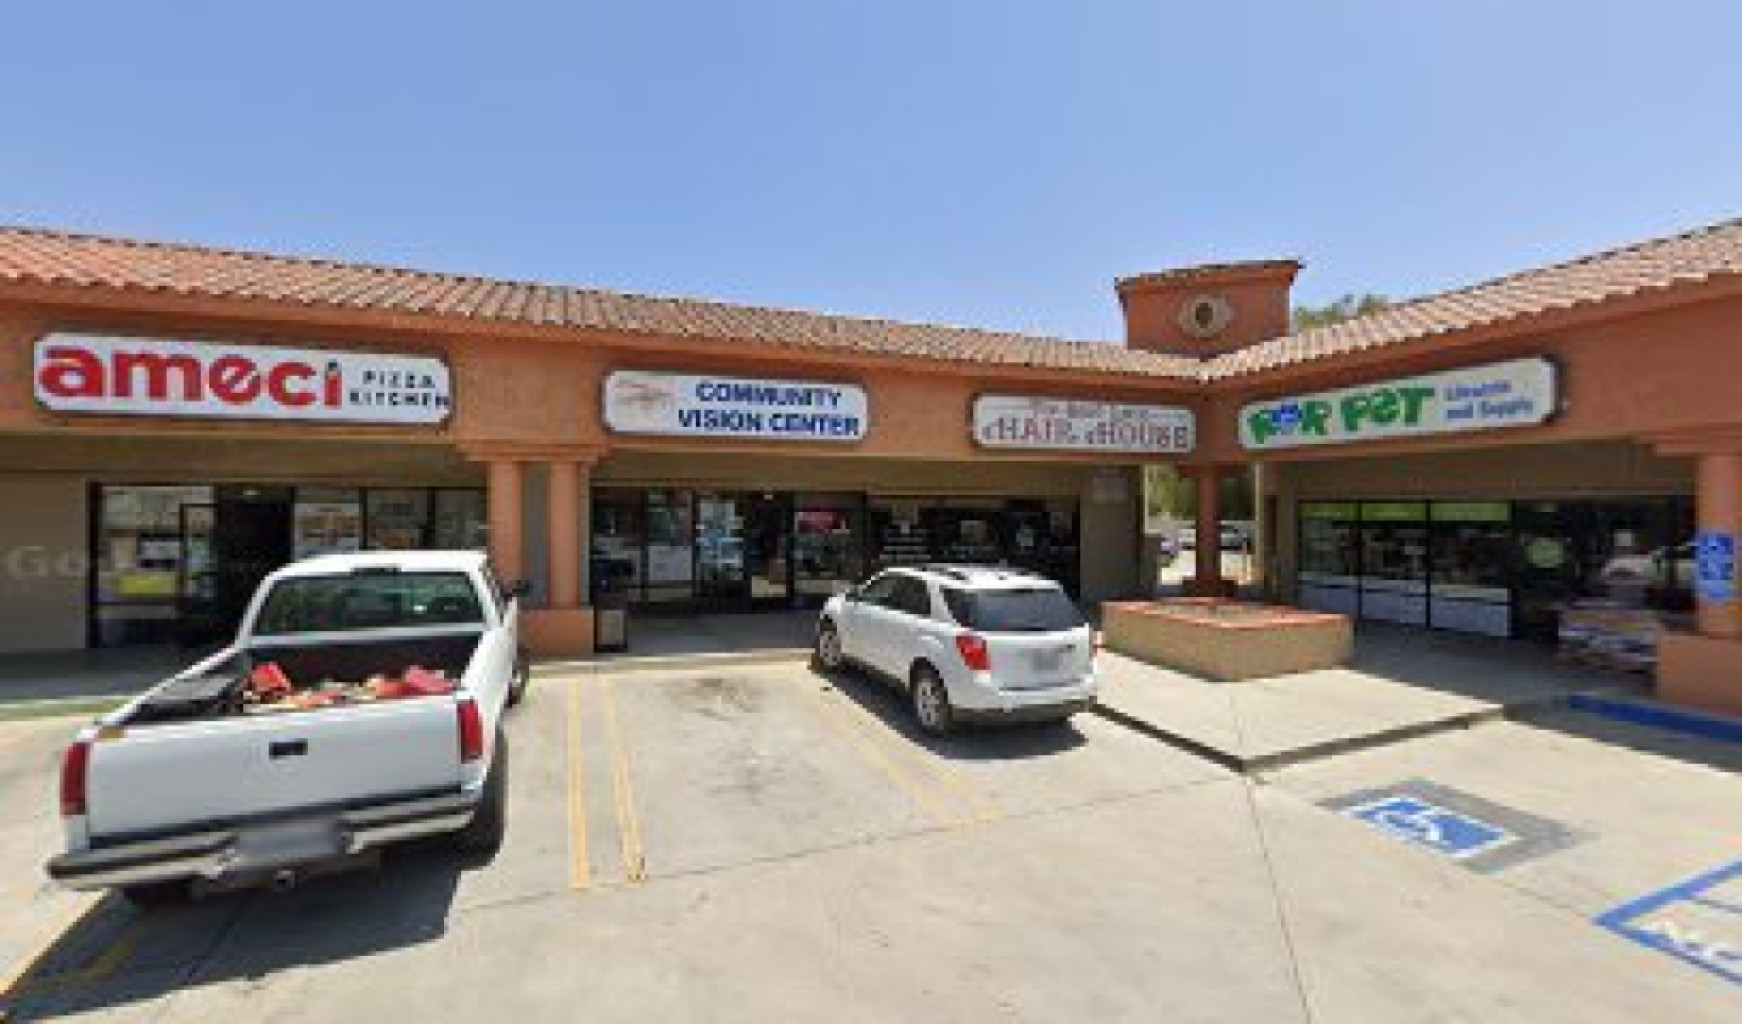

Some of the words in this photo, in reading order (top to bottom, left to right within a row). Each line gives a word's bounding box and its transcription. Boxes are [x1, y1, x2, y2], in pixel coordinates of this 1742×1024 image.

[38, 345, 343, 411] ameci
[362, 369, 437, 389] PIZZA
[348, 390, 450, 409] KITCHEN
[696, 382, 842, 407] COMMUNITY
[677, 409, 761, 430] VISION
[769, 414, 860, 436] CENTER
